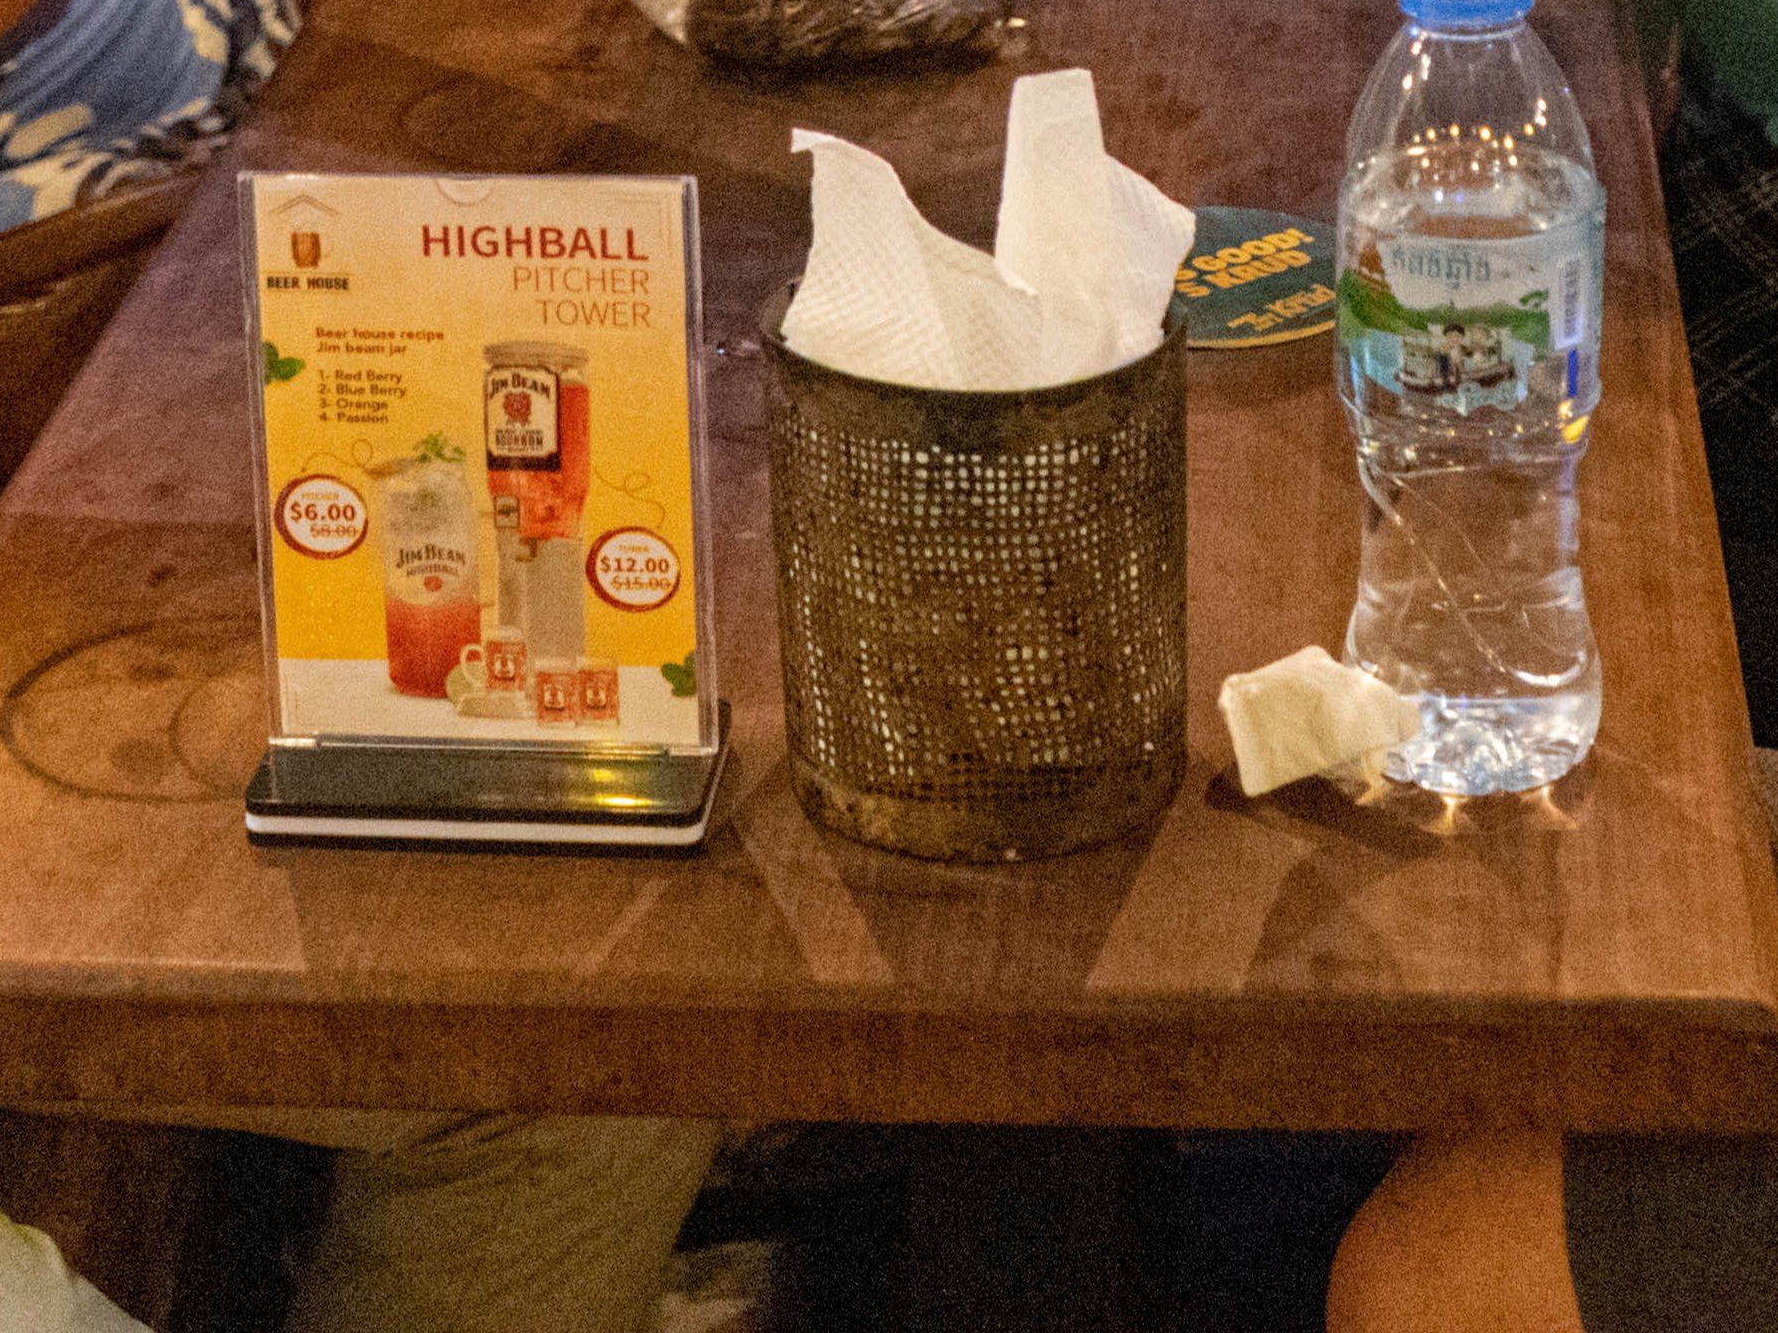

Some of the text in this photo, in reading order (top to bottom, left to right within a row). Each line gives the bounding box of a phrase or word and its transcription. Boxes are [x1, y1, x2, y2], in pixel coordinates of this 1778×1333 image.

[421, 224, 650, 262] HIGHBALL
[266, 276, 350, 291] BEER HOUSE
[512, 265, 650, 294] PITCHER
[535, 299, 652, 328] TOWER
[336, 397, 389, 413] Orange
[290, 501, 356, 523] $6.00
[600, 556, 669, 573] $12.00
